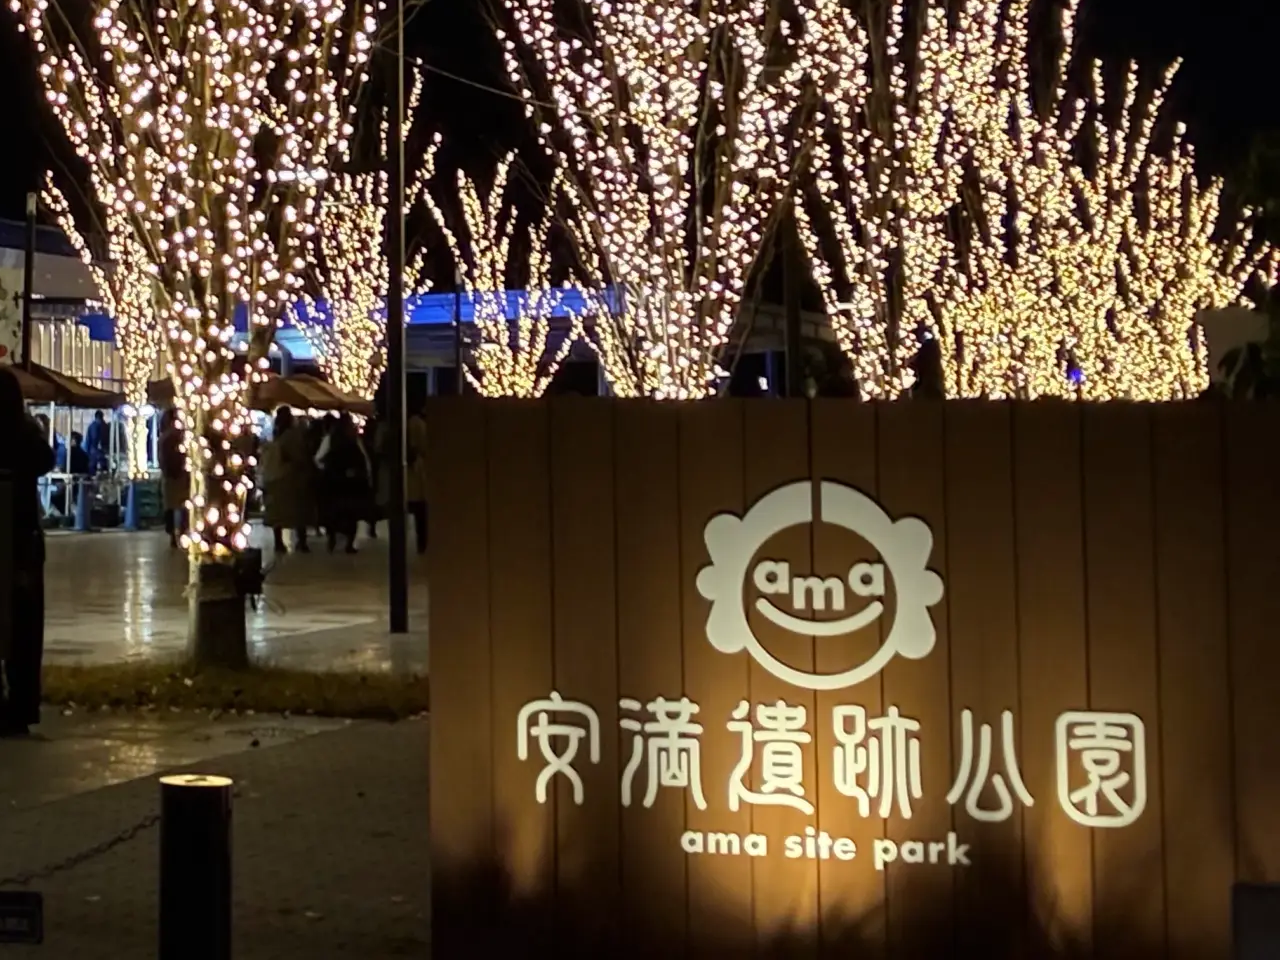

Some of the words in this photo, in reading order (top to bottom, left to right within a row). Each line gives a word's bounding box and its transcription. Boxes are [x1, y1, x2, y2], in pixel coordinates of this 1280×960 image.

[753, 559, 886, 611] ama
[517, 691, 1148, 829] 安満遺跡公園
[679, 829, 768, 857] ama
[783, 825, 857, 861] site
[873, 831, 972, 871] park
